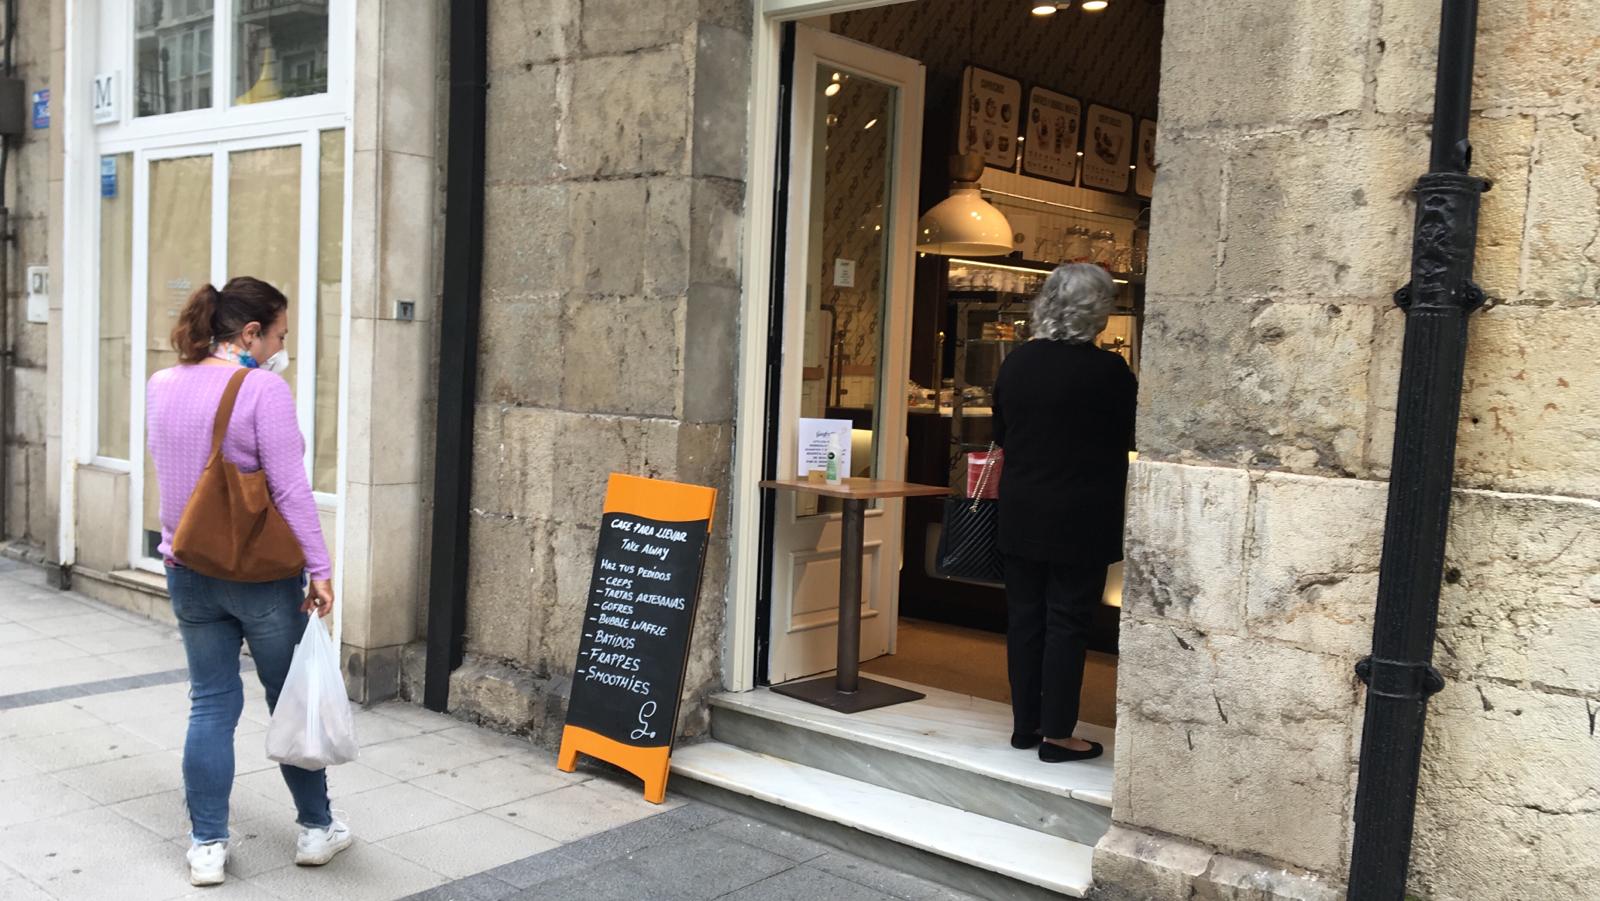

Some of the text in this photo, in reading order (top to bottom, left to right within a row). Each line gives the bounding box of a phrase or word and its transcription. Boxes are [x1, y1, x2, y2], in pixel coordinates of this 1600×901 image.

[96, 76, 112, 109] M
[633, 523, 655, 536] PARA
[655, 528, 687, 542] LLEVAR
[619, 564, 635, 574] TUS
[600, 601, 634, 615] GOFRES
[604, 588, 685, 610] TARTAS ARTESANAS
[598, 613, 668, 636] BUBBLE WAFFLE
[589, 648, 641, 672] FRAPPES
[585, 665, 651, 695] SMOOTHIES
